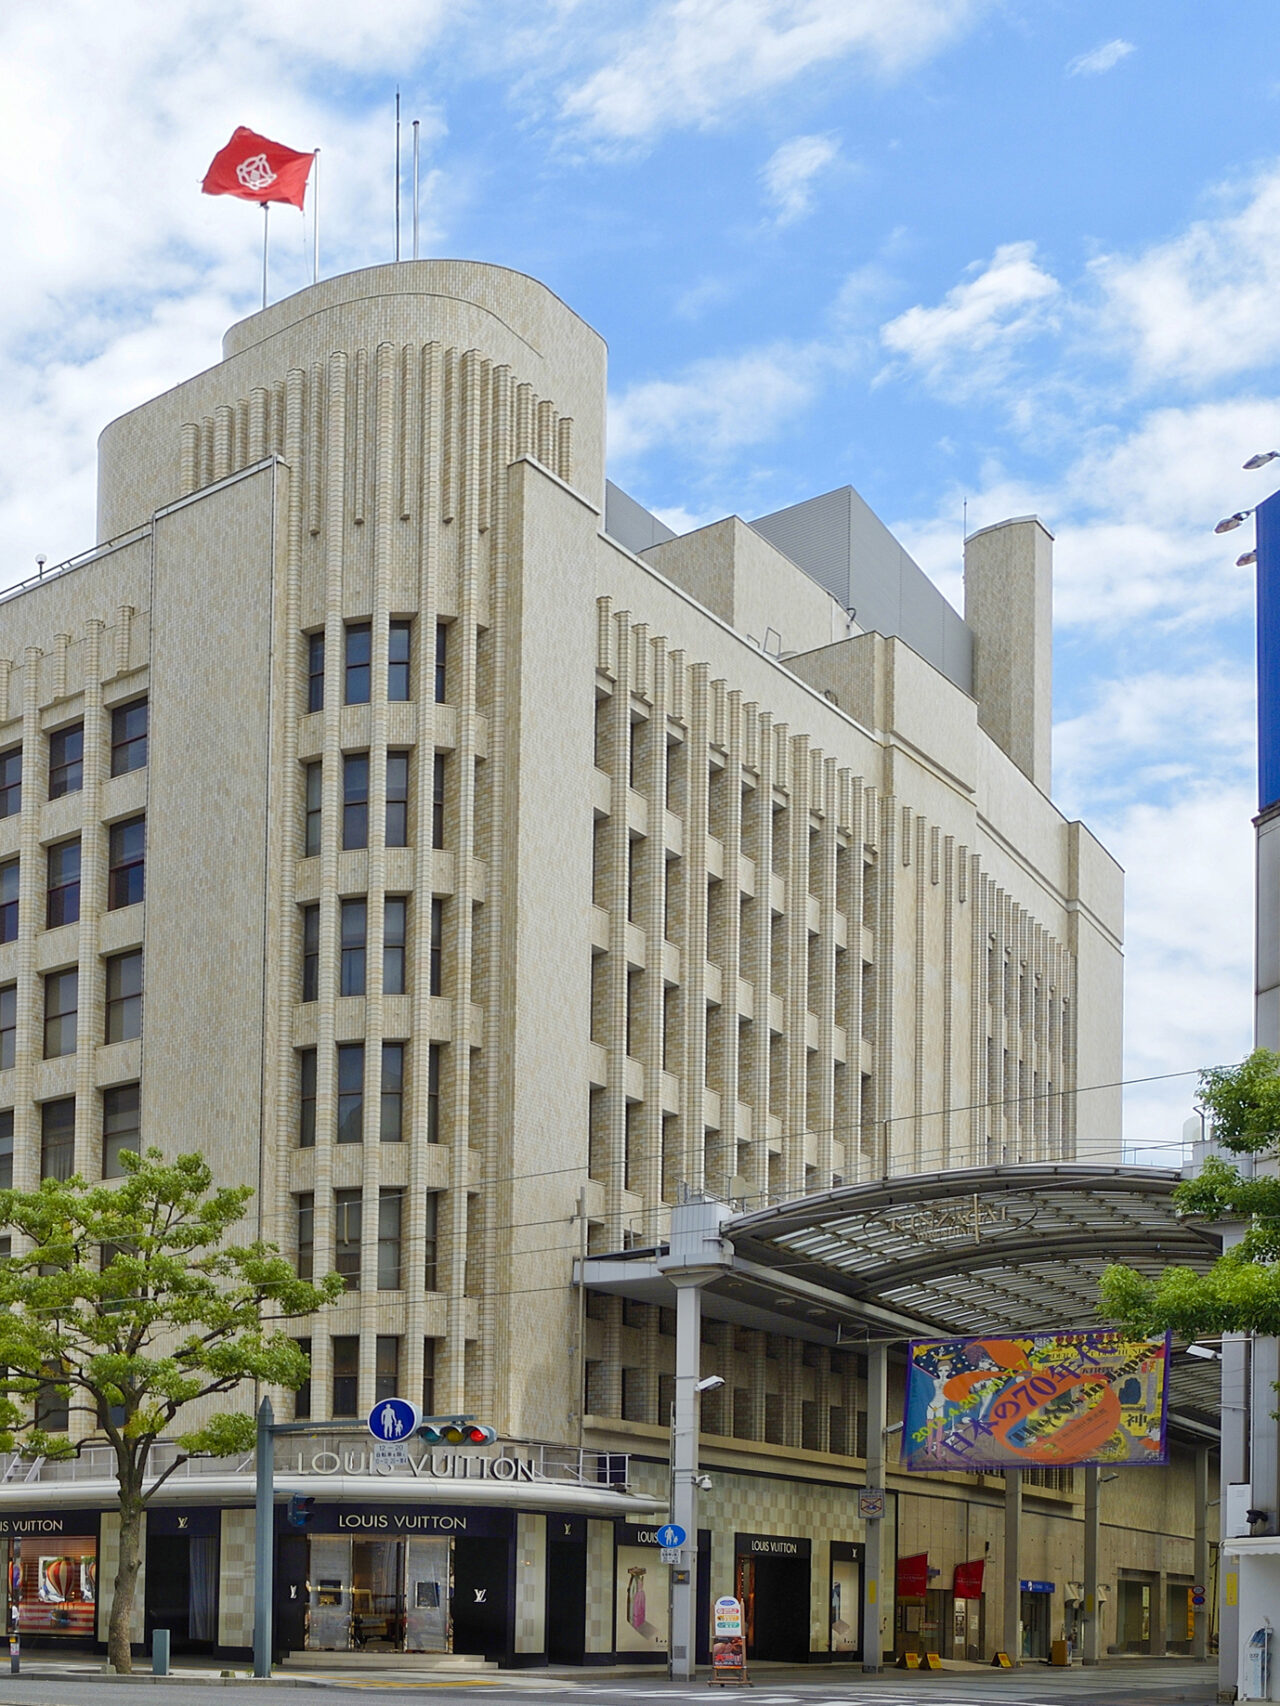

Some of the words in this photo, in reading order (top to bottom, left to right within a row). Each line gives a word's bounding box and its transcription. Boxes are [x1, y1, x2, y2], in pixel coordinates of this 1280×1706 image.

[941, 1341, 1118, 1457] 日本の70年代
[407, 1453, 535, 1482] VUITTON
[11, 1519, 63, 1532] VUITTON
[339, 1514, 388, 1529] LOUIS
[393, 1515, 467, 1530] VUITTON
[637, 1530, 658, 1544] LOUIS
[751, 1540, 770, 1552] LOUIS
[770, 1541, 797, 1554] VUITTON
